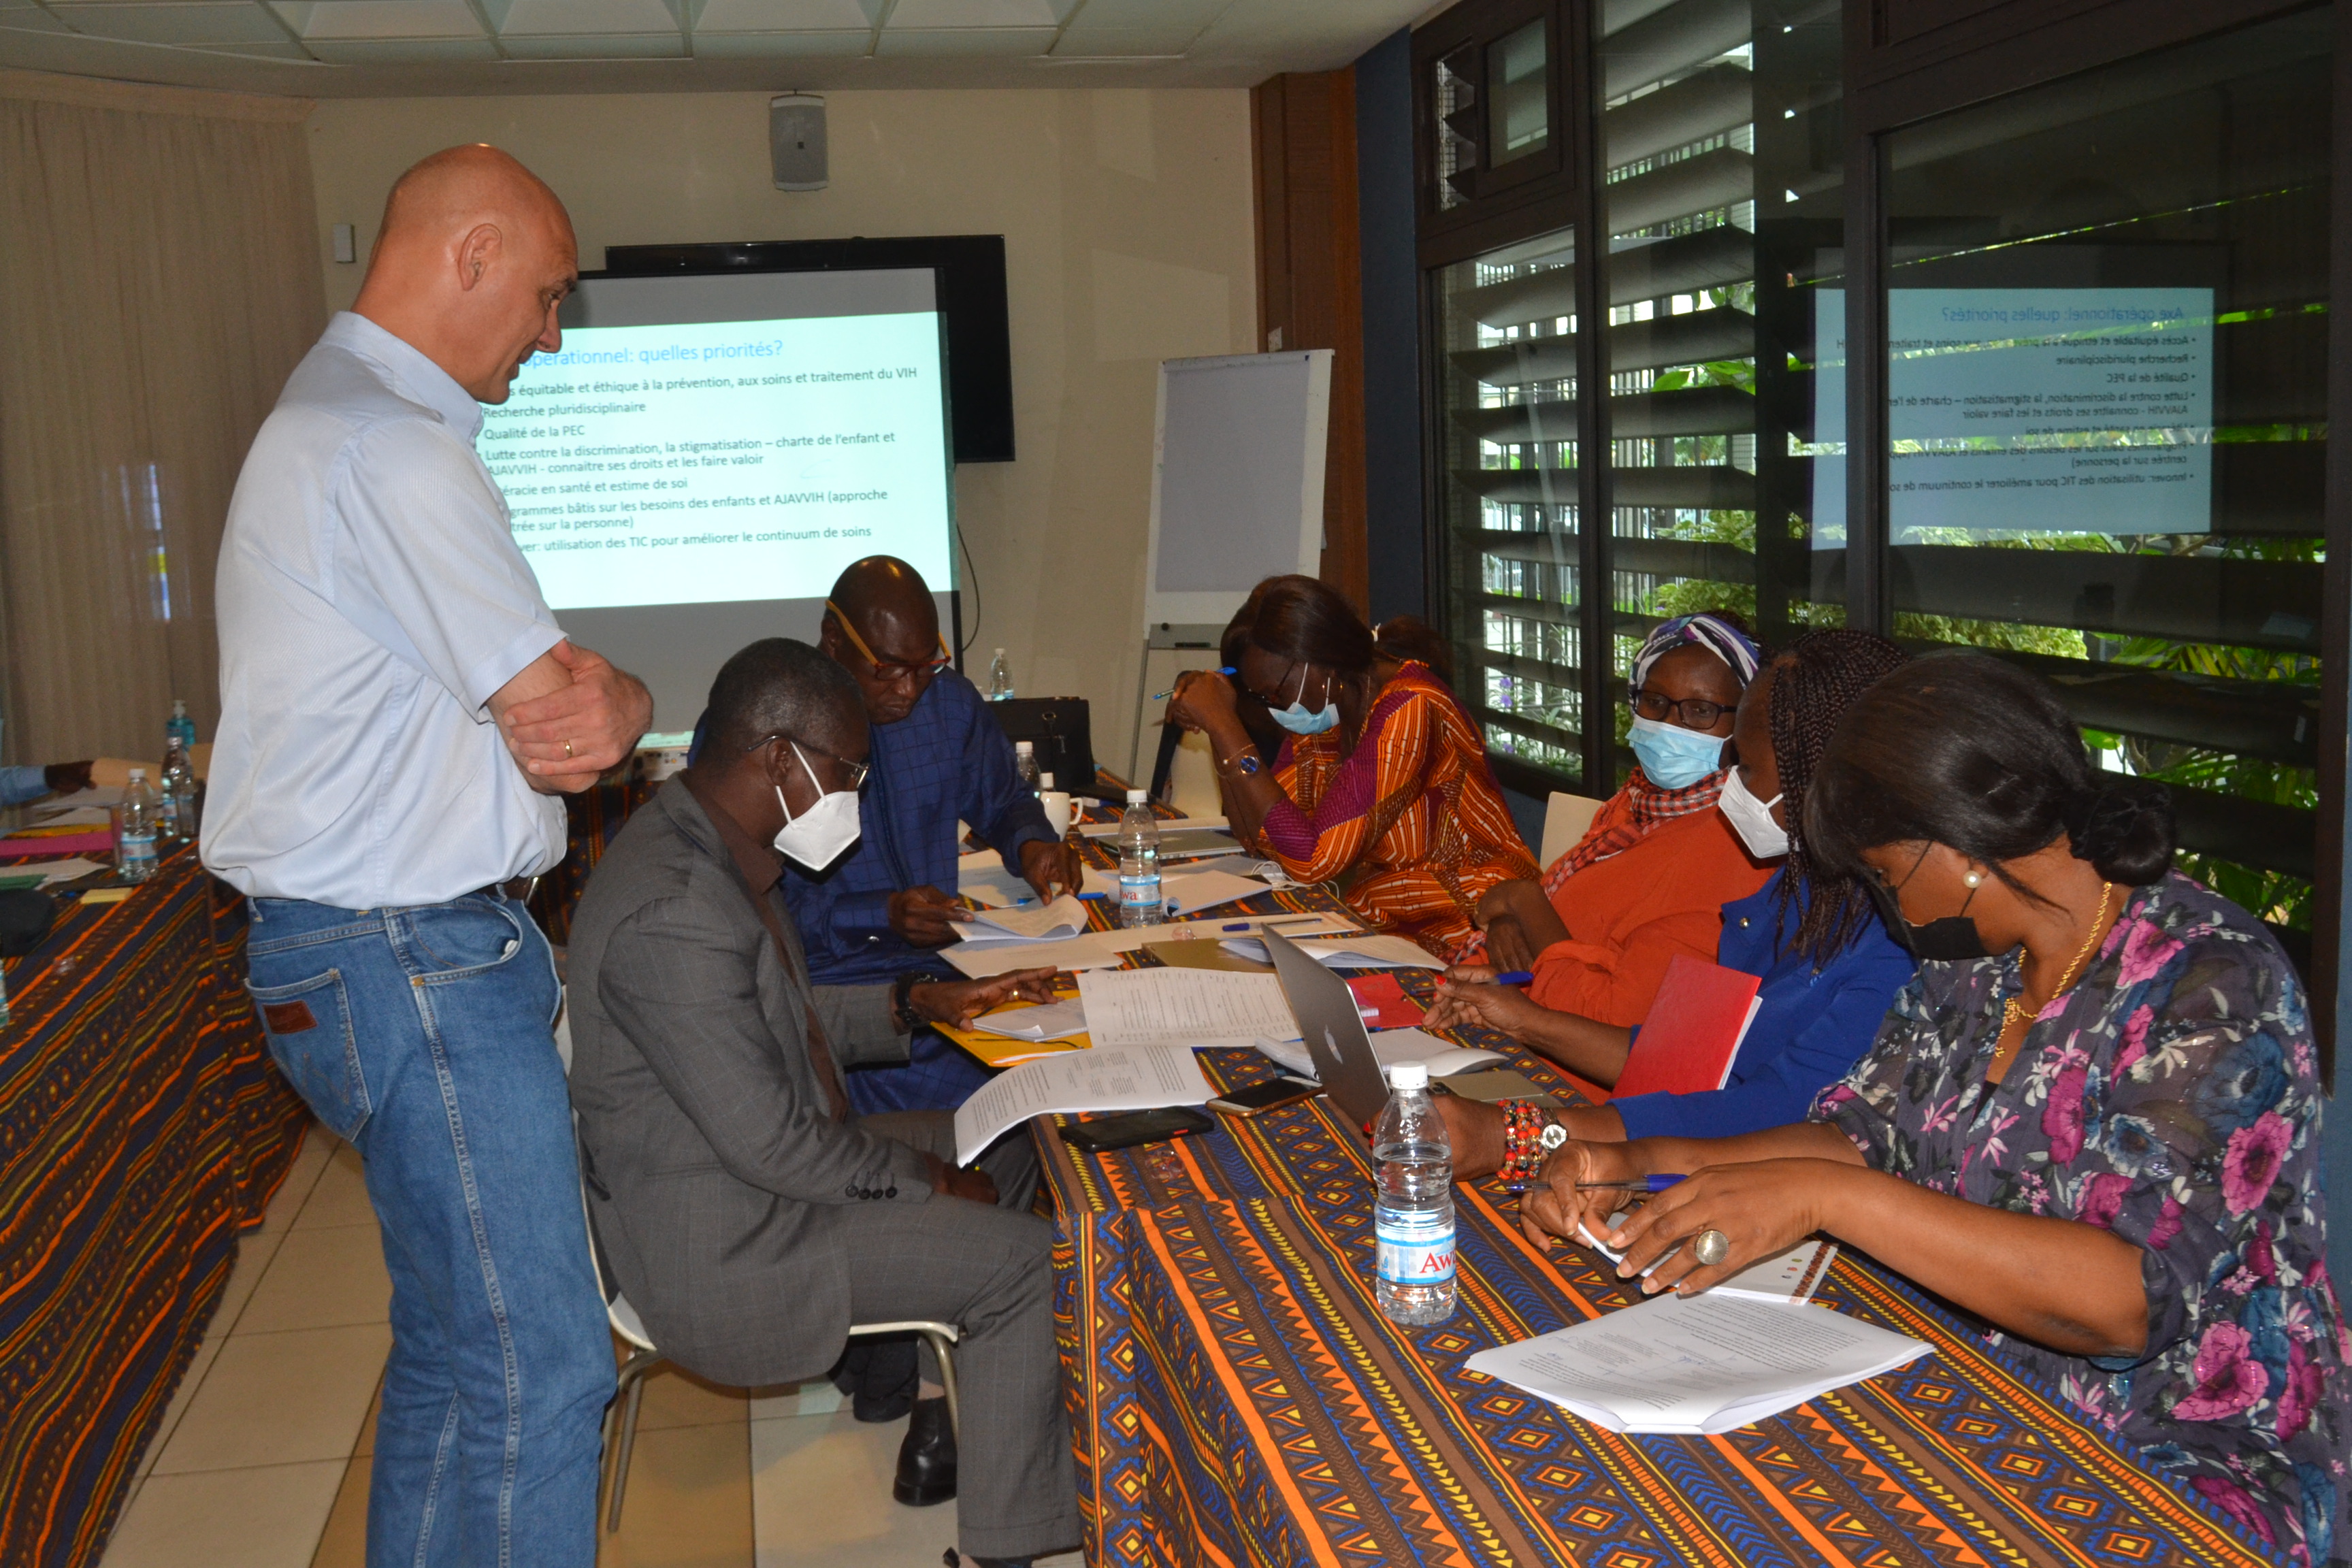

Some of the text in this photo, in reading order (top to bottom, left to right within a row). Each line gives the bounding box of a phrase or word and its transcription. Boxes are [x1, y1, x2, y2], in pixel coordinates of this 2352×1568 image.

[639, 345, 699, 365] quelles
[703, 340, 783, 362] priorités?
[519, 382, 575, 397] équitable
[577, 382, 591, 393] et
[592, 380, 640, 394] éthique
[642, 378, 650, 391] à
[652, 378, 664, 390] la
[666, 376, 735, 391] prévention,
[737, 376, 760, 387] aux
[761, 372, 793, 385] soins
[794, 372, 808, 383] et
[810, 369, 875, 382] traitement
[877, 367, 894, 379] du
[895, 366, 917, 378] VIH
[483, 401, 647, 418] Recherche pluridisciplinaire
[485, 423, 585, 440] Qualité de la PEC
[485, 450, 517, 461] Lutte
[519, 448, 558, 459] contre
[560, 446, 572, 457] la
[574, 444, 663, 457] discrimination,
[665, 441, 676, 453] la
[679, 439, 763, 454] stigmatisation
[775, 436, 815, 448] charte
[816, 434, 833, 445] de
[882, 431, 896, 442] et
[607, 461, 627, 471] ses
[629, 458, 664, 470] droits
[666, 457, 679, 468] et
[681, 455, 699, 468] les
[700, 454, 728, 466] faire
[730, 453, 764, 465] valoir
[540, 485, 557, 495] en
[559, 482, 592, 493] santé
[593, 481, 608, 492] et
[609, 480, 651, 491] estime
[652, 478, 668, 489] de
[670, 478, 689, 489] soi
[510, 488, 888, 519] grammes bâtis sur les besoins des enfants et AJAVVIH (approche
[510, 515, 634, 532] trée sur la personne)
[544, 538, 603, 551] utilisation
[605, 537, 627, 549] des
[629, 535, 649, 546] TIC
[651, 536, 679, 548] pour
[681, 532, 740, 545] améliorer
[742, 530, 754, 542] le
[755, 529, 821, 542] continuum
[822, 526, 839, 538] de
[841, 527, 872, 538] soins
[1120, 891, 1138, 900] wa
